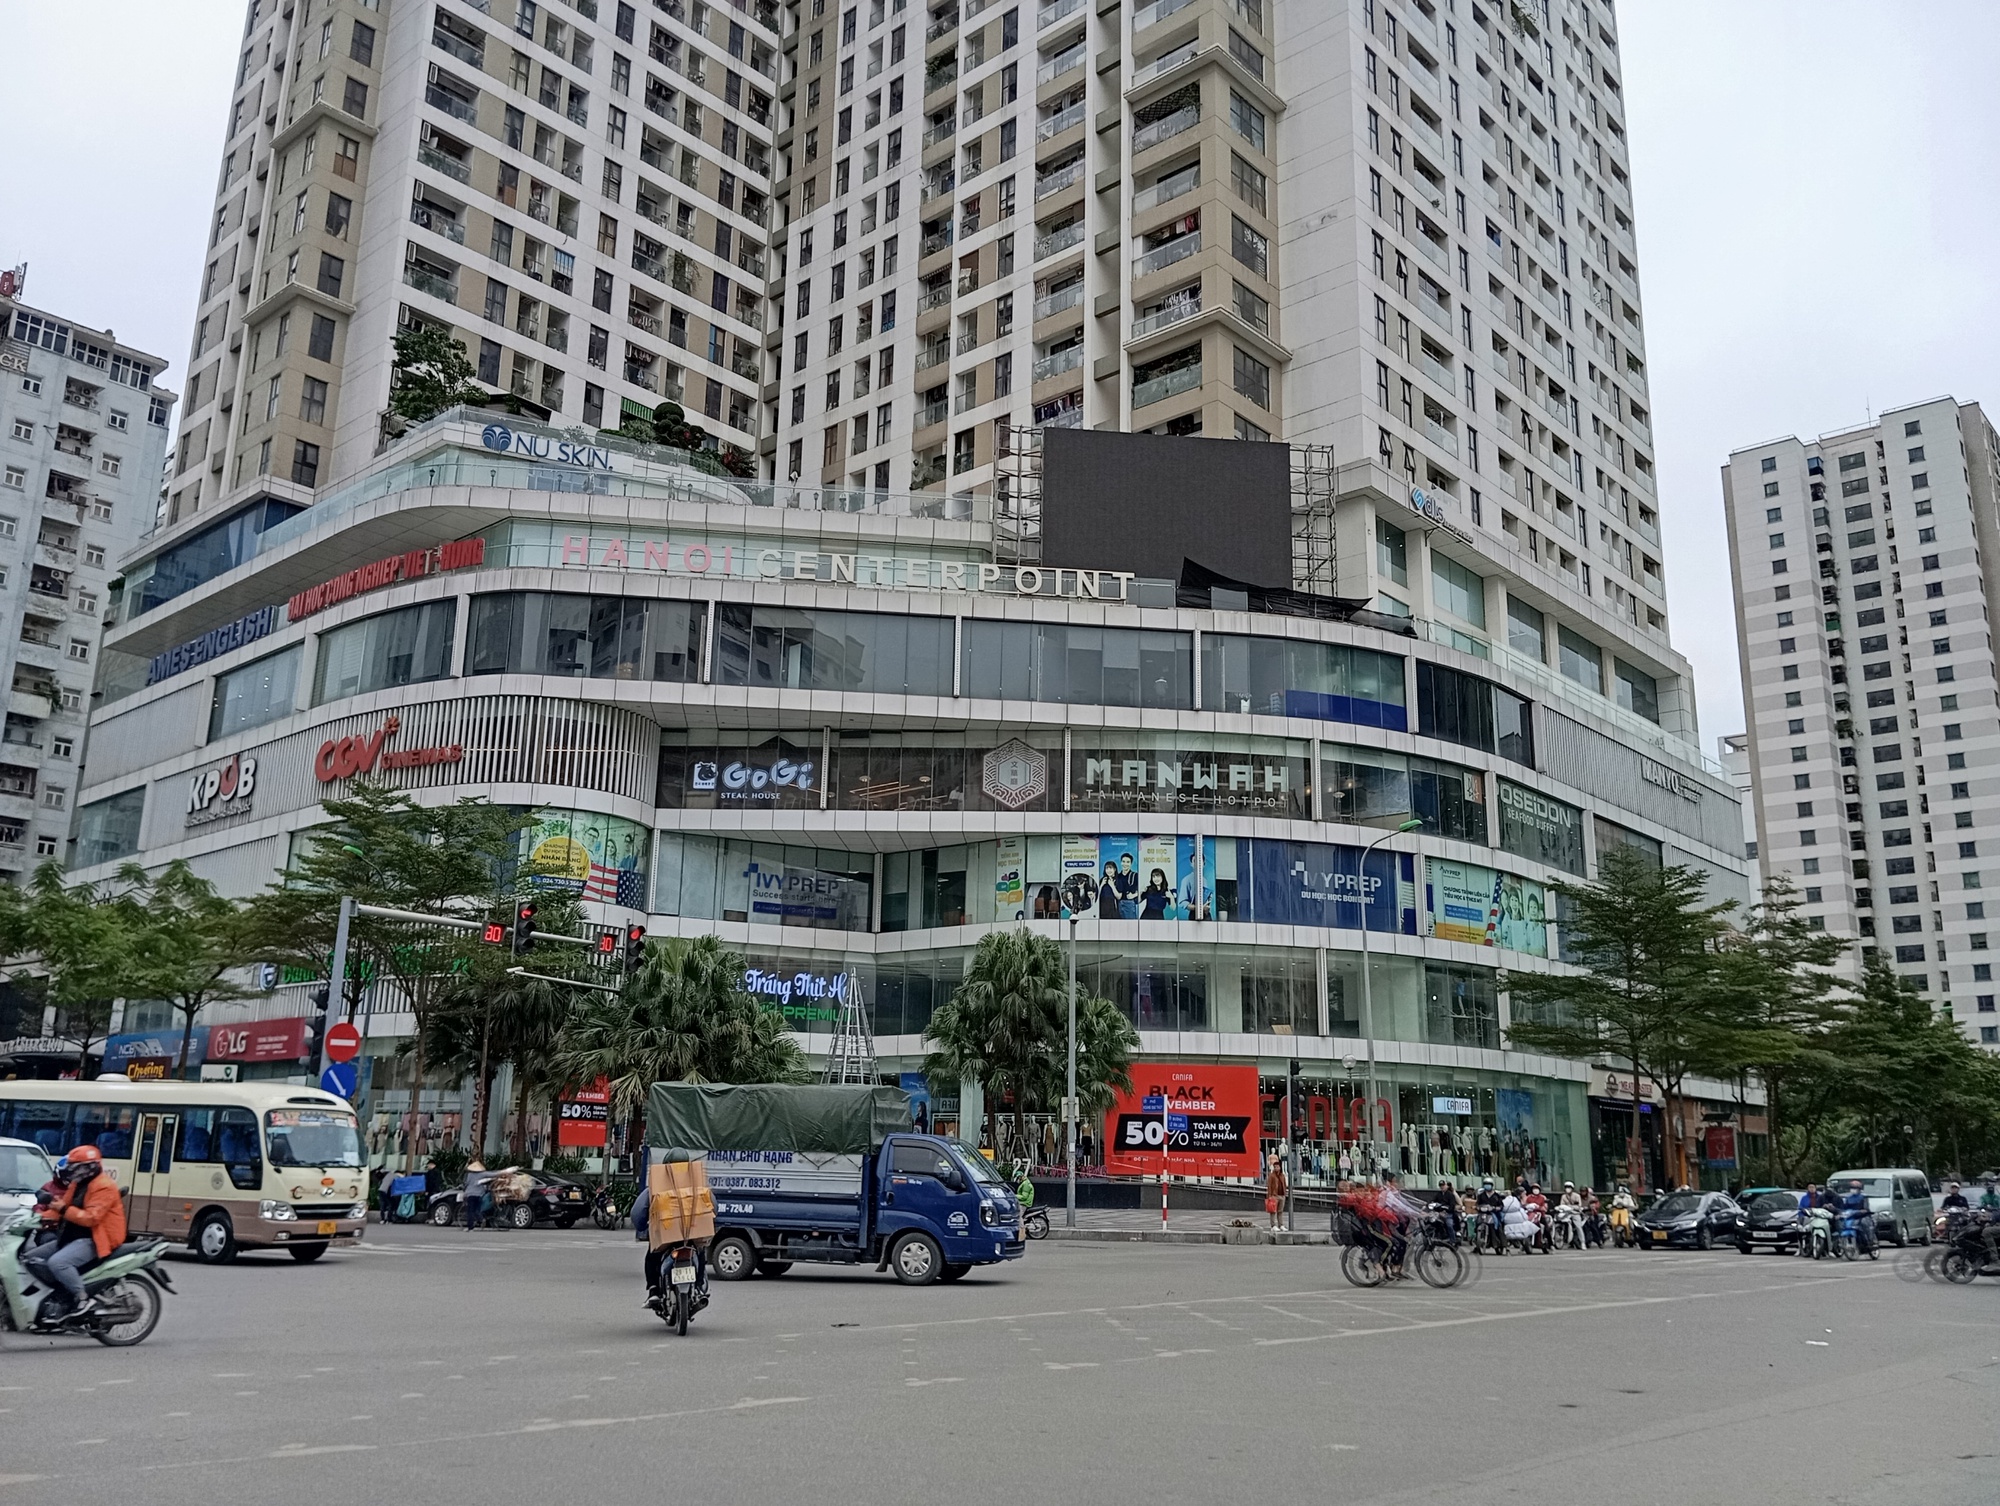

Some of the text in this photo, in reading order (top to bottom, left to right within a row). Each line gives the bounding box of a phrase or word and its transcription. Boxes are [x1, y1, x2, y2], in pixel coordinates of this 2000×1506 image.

[515, 434, 609, 470] NU SKIN
[562, 535, 1135, 600] HANOI CENTERPOINT
[146, 604, 274, 686] AMES ENGLISH
[314, 728, 463, 784] CGV CINEMAS
[1085, 758, 1290, 793] MANWAH
[751, 792, 781, 800] HOUSE
[1086, 789, 1200, 804] TAIWANESE
[752, 889, 788, 900] Success
[230, 1031, 250, 1054] LG
[1172, 1073, 1193, 1081] CANIFA
[1150, 1085, 1214, 1100] BLACK
[561, 1104, 592, 1119] 50%
[1446, 1101, 1470, 1113] CANIFA
[1193, 1121, 1216, 1130] TOÀN
[1125, 1121, 1189, 1146] 50%
[1193, 1130, 1211, 1139] SẢN
[749, 1178, 781, 1189] 083.312
